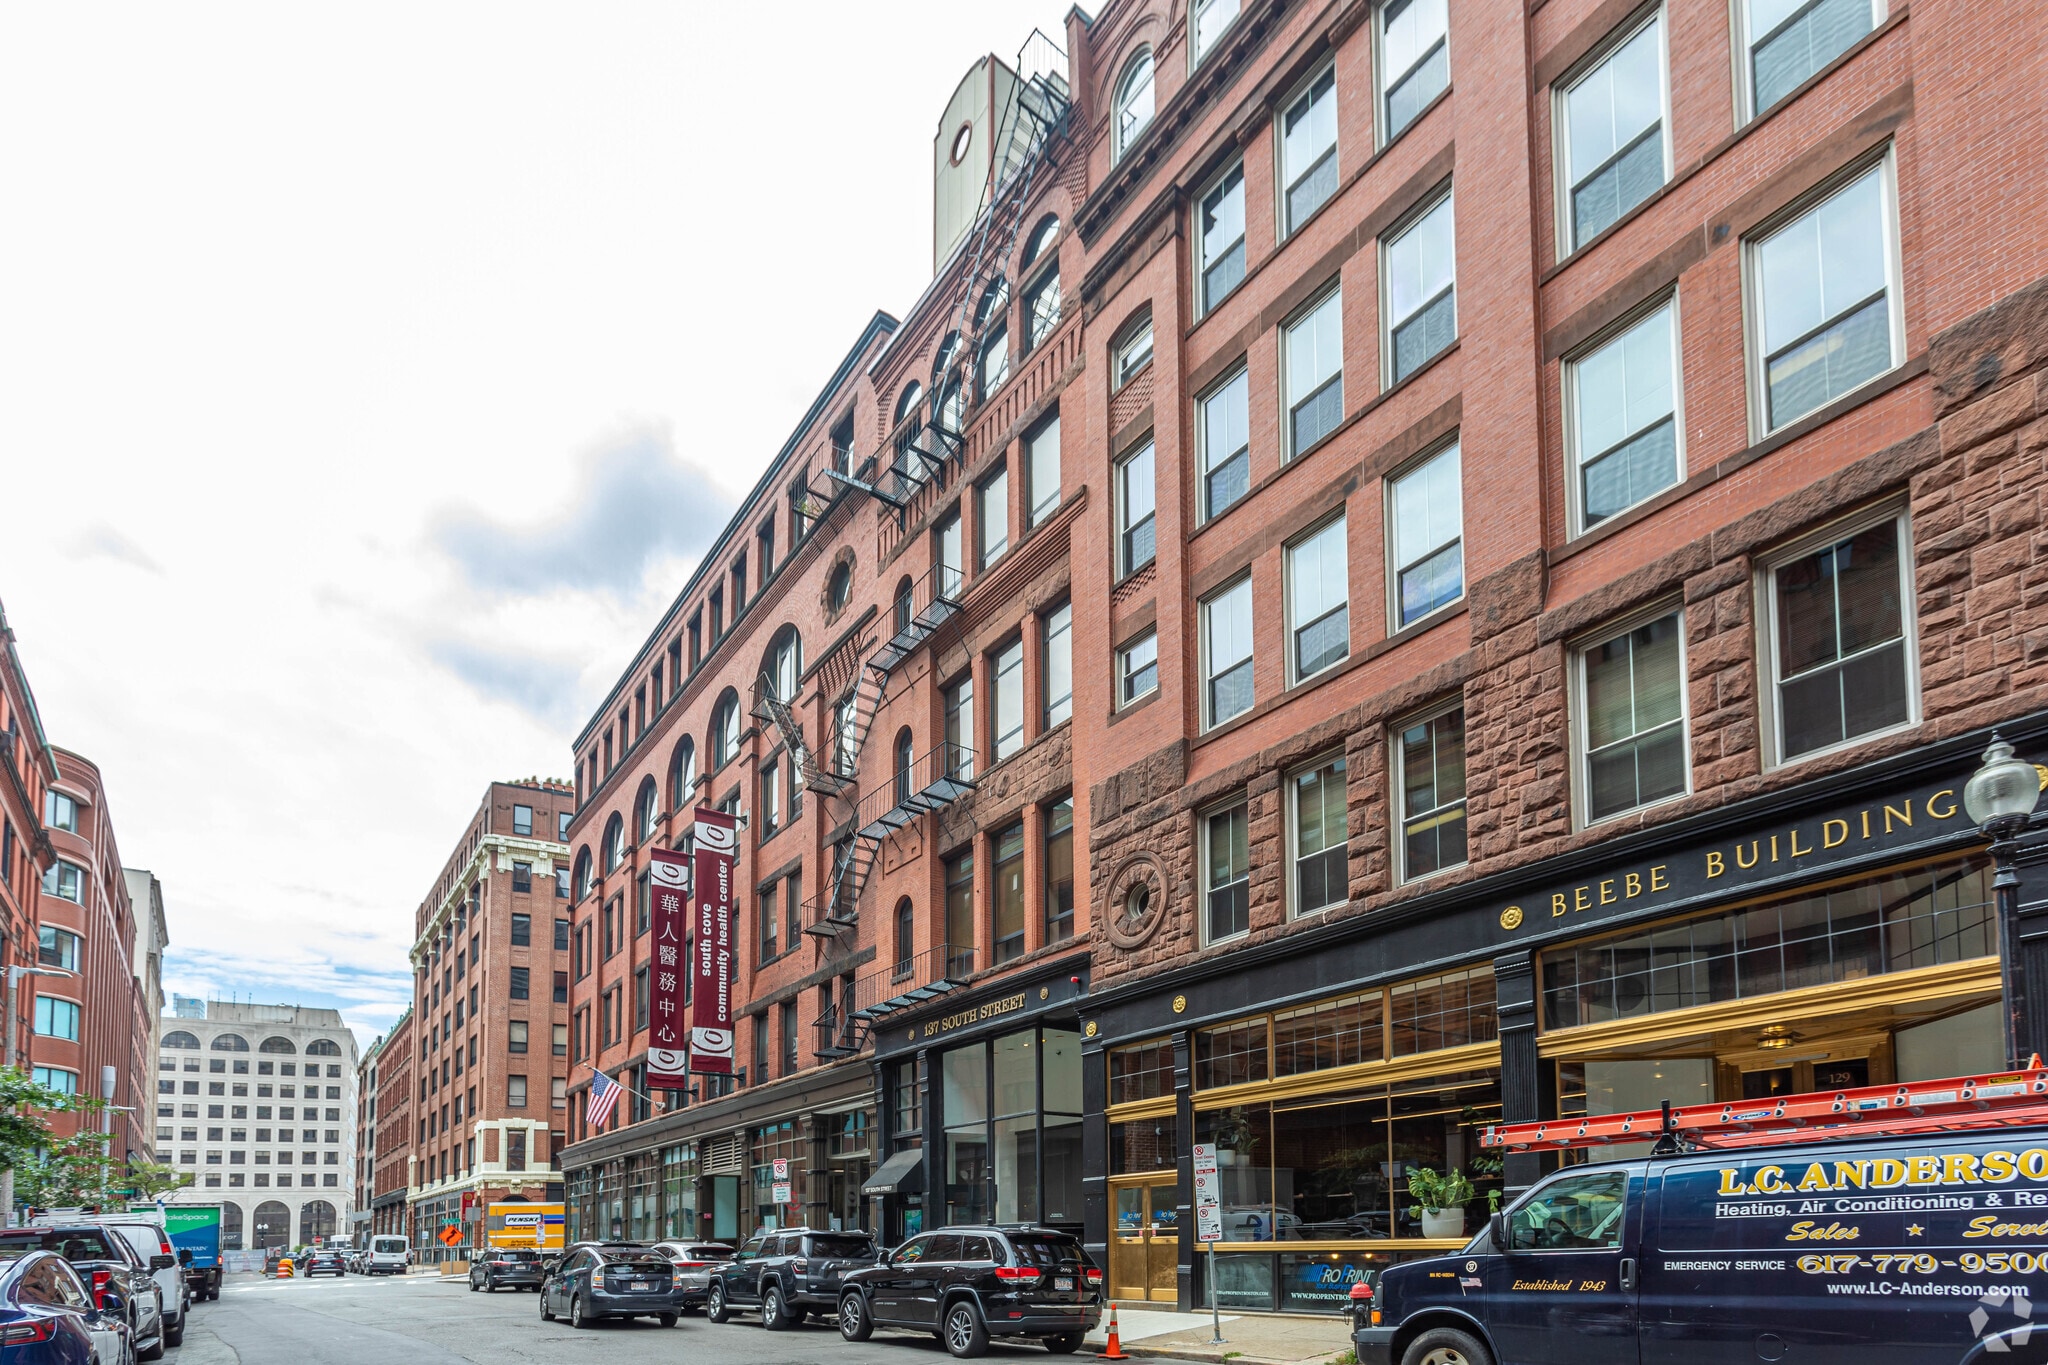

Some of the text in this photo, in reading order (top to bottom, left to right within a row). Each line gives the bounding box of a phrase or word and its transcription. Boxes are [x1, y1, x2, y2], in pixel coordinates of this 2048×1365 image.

[1551, 790, 1958, 918] BEEBE BUILDING
[700, 903, 711, 976] south cove
[717, 859, 730, 1022] community health center
[658, 893, 680, 1043] 華人醫務中心
[924, 992, 1026, 1037] 137 SOUTH STREET
[1829, 1072, 1850, 1083] 129
[1715, 1203, 1791, 1217] Heating,
[1799, 1201, 1827, 1214] Air
[1834, 1195, 1974, 1213] Conditioning
[1985, 1193, 2003, 1207] &
[1785, 1221, 1860, 1241] Sales
[1664, 1261, 1731, 1272] EMERGENCY
[1735, 1260, 1785, 1271] SERVICE
[1512, 1279, 1606, 1292] Established 1943
[1827, 1281, 2029, 1297] www.LC-Anderson.com
